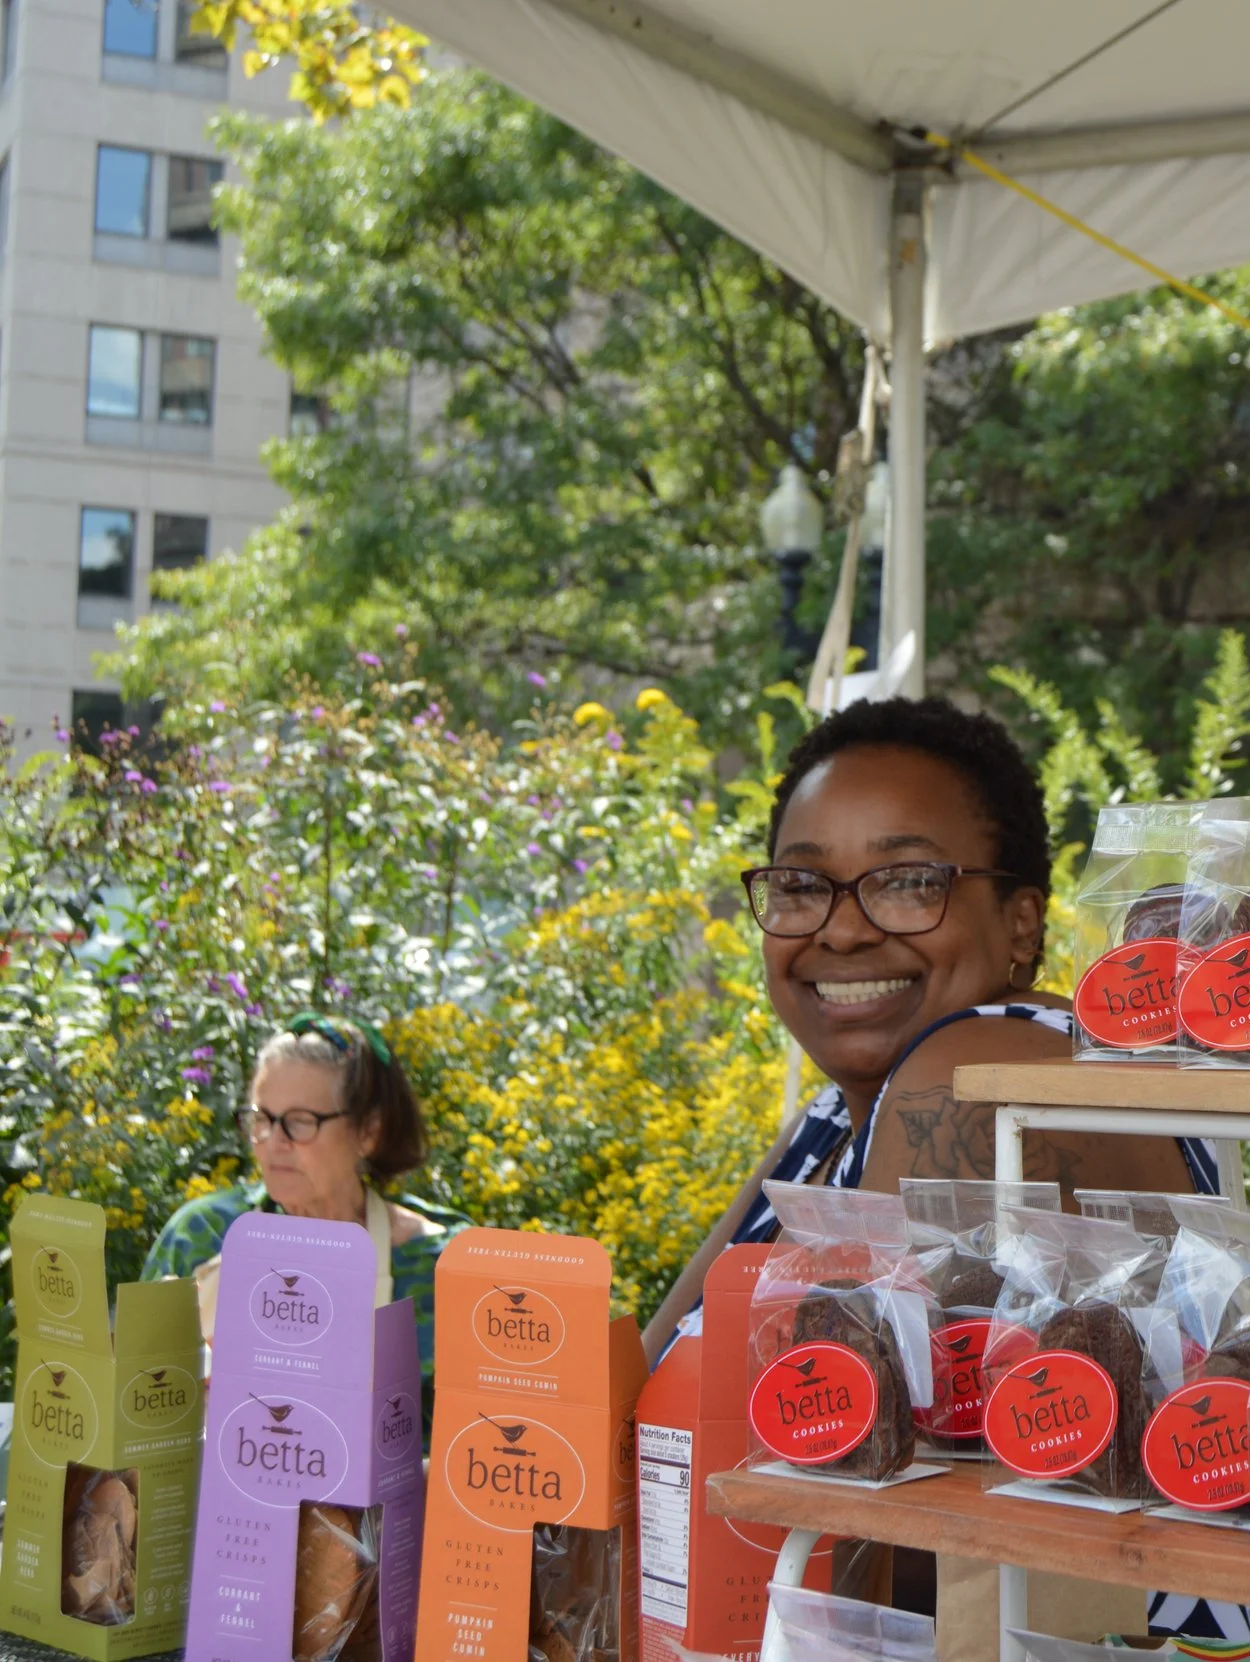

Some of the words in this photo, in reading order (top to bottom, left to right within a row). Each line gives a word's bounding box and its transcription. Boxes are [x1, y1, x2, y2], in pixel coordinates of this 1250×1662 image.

[1102, 975, 1181, 1016] betta
[1122, 1005, 1177, 1027] COOKIES
[534, 1253, 585, 1265] GOODNESS
[38, 1266, 75, 1298] betta
[262, 1291, 320, 1325] betta
[487, 1309, 551, 1343] betta
[478, 1373, 511, 1385] PUMPKIN
[134, 1389, 187, 1412] betta
[775, 1385, 853, 1426] betta
[946, 1399, 983, 1413] COOK
[31, 1390, 84, 1440] betta
[1009, 1394, 1091, 1439] betta
[383, 1416, 413, 1443] betta
[639, 1426, 670, 1441] Nutrition
[671, 1431, 691, 1445] Facts
[792, 1419, 845, 1439] COOKIES
[1030, 1429, 1083, 1453] COOKIES
[237, 1426, 327, 1478] betta
[467, 1448, 562, 1501] betta
[640, 1466, 660, 1480] Calories
[679, 1470, 690, 1486] 90
[1192, 1459, 1250, 1484] COOKIES
[489, 1499, 536, 1513] BAKES
[216, 1515, 272, 1531] GLUTEN
[225, 1533, 260, 1547] FREE
[445, 1540, 504, 1556] GLUTEN
[216, 1549, 267, 1565] CRISPS
[455, 1558, 492, 1572] FREE
[445, 1575, 501, 1591] CRISPS
[726, 1575, 773, 1586] GLU
[218, 1586, 261, 1601] CURRANT
[220, 1614, 256, 1629] FENNEL
[448, 1612, 494, 1630] PUMPKIN
[728, 1612, 760, 1622] CRI
[457, 1628, 482, 1642] SEED
[452, 1642, 486, 1657] CUMIN
